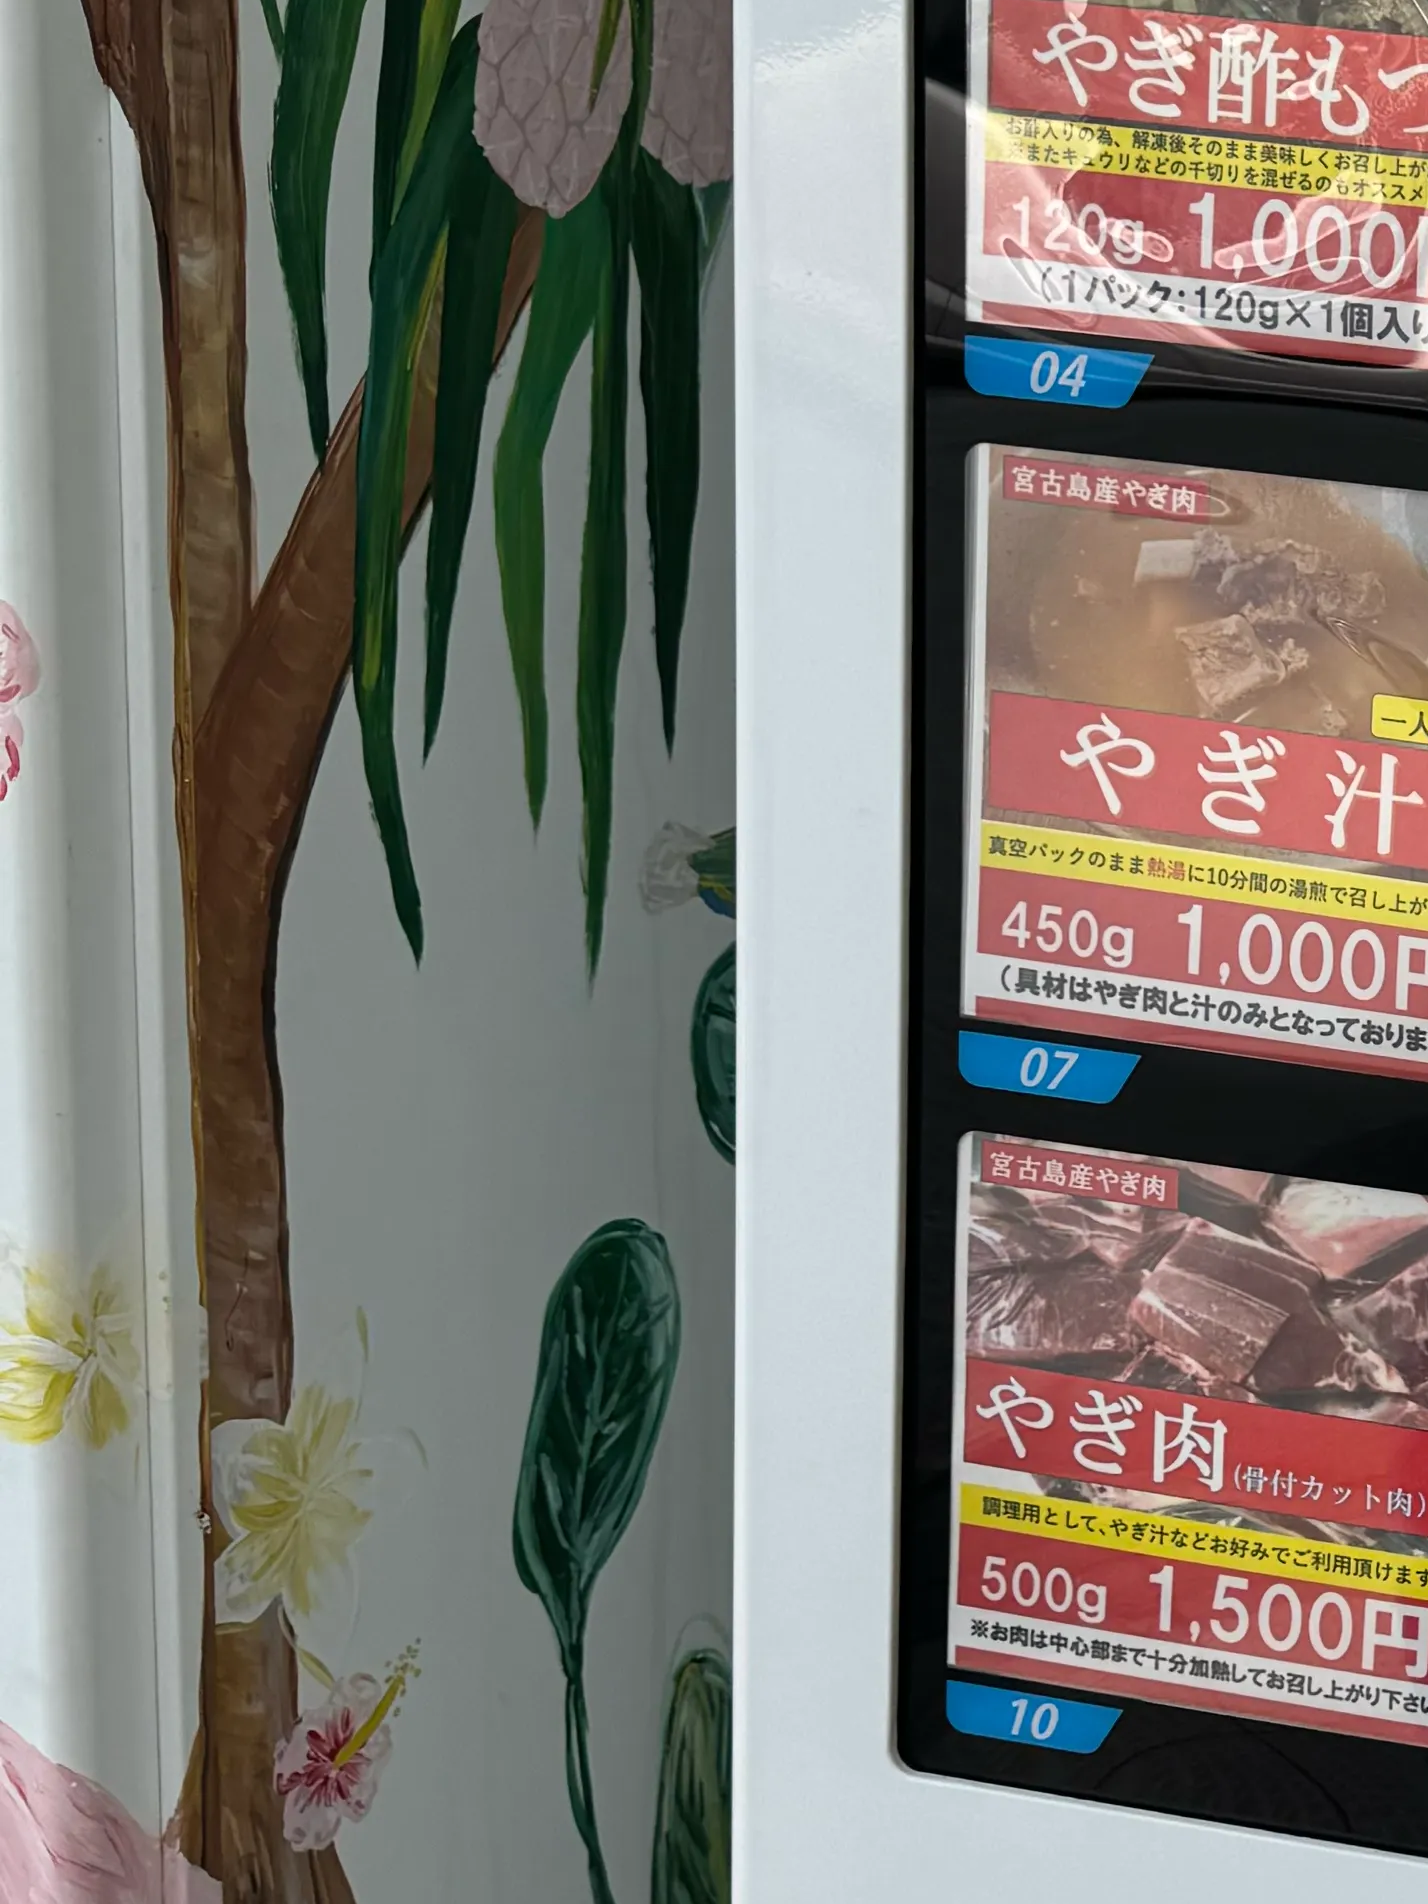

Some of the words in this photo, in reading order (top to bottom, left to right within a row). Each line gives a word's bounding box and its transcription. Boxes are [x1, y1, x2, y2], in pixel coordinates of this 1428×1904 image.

[1012, 196, 1145, 265] 120g
[1029, 349, 1090, 397] 04
[1011, 465, 1197, 514] 宮古島産やぎ肉
[1059, 713, 1425, 856] やぎ汁
[1001, 900, 1135, 968] 450g
[1019, 1046, 1080, 1090] 07
[989, 1151, 1167, 1202] 宮古島産やぎ肉
[980, 1555, 1107, 1624] 500g
[1008, 1698, 1060, 1740] 10
